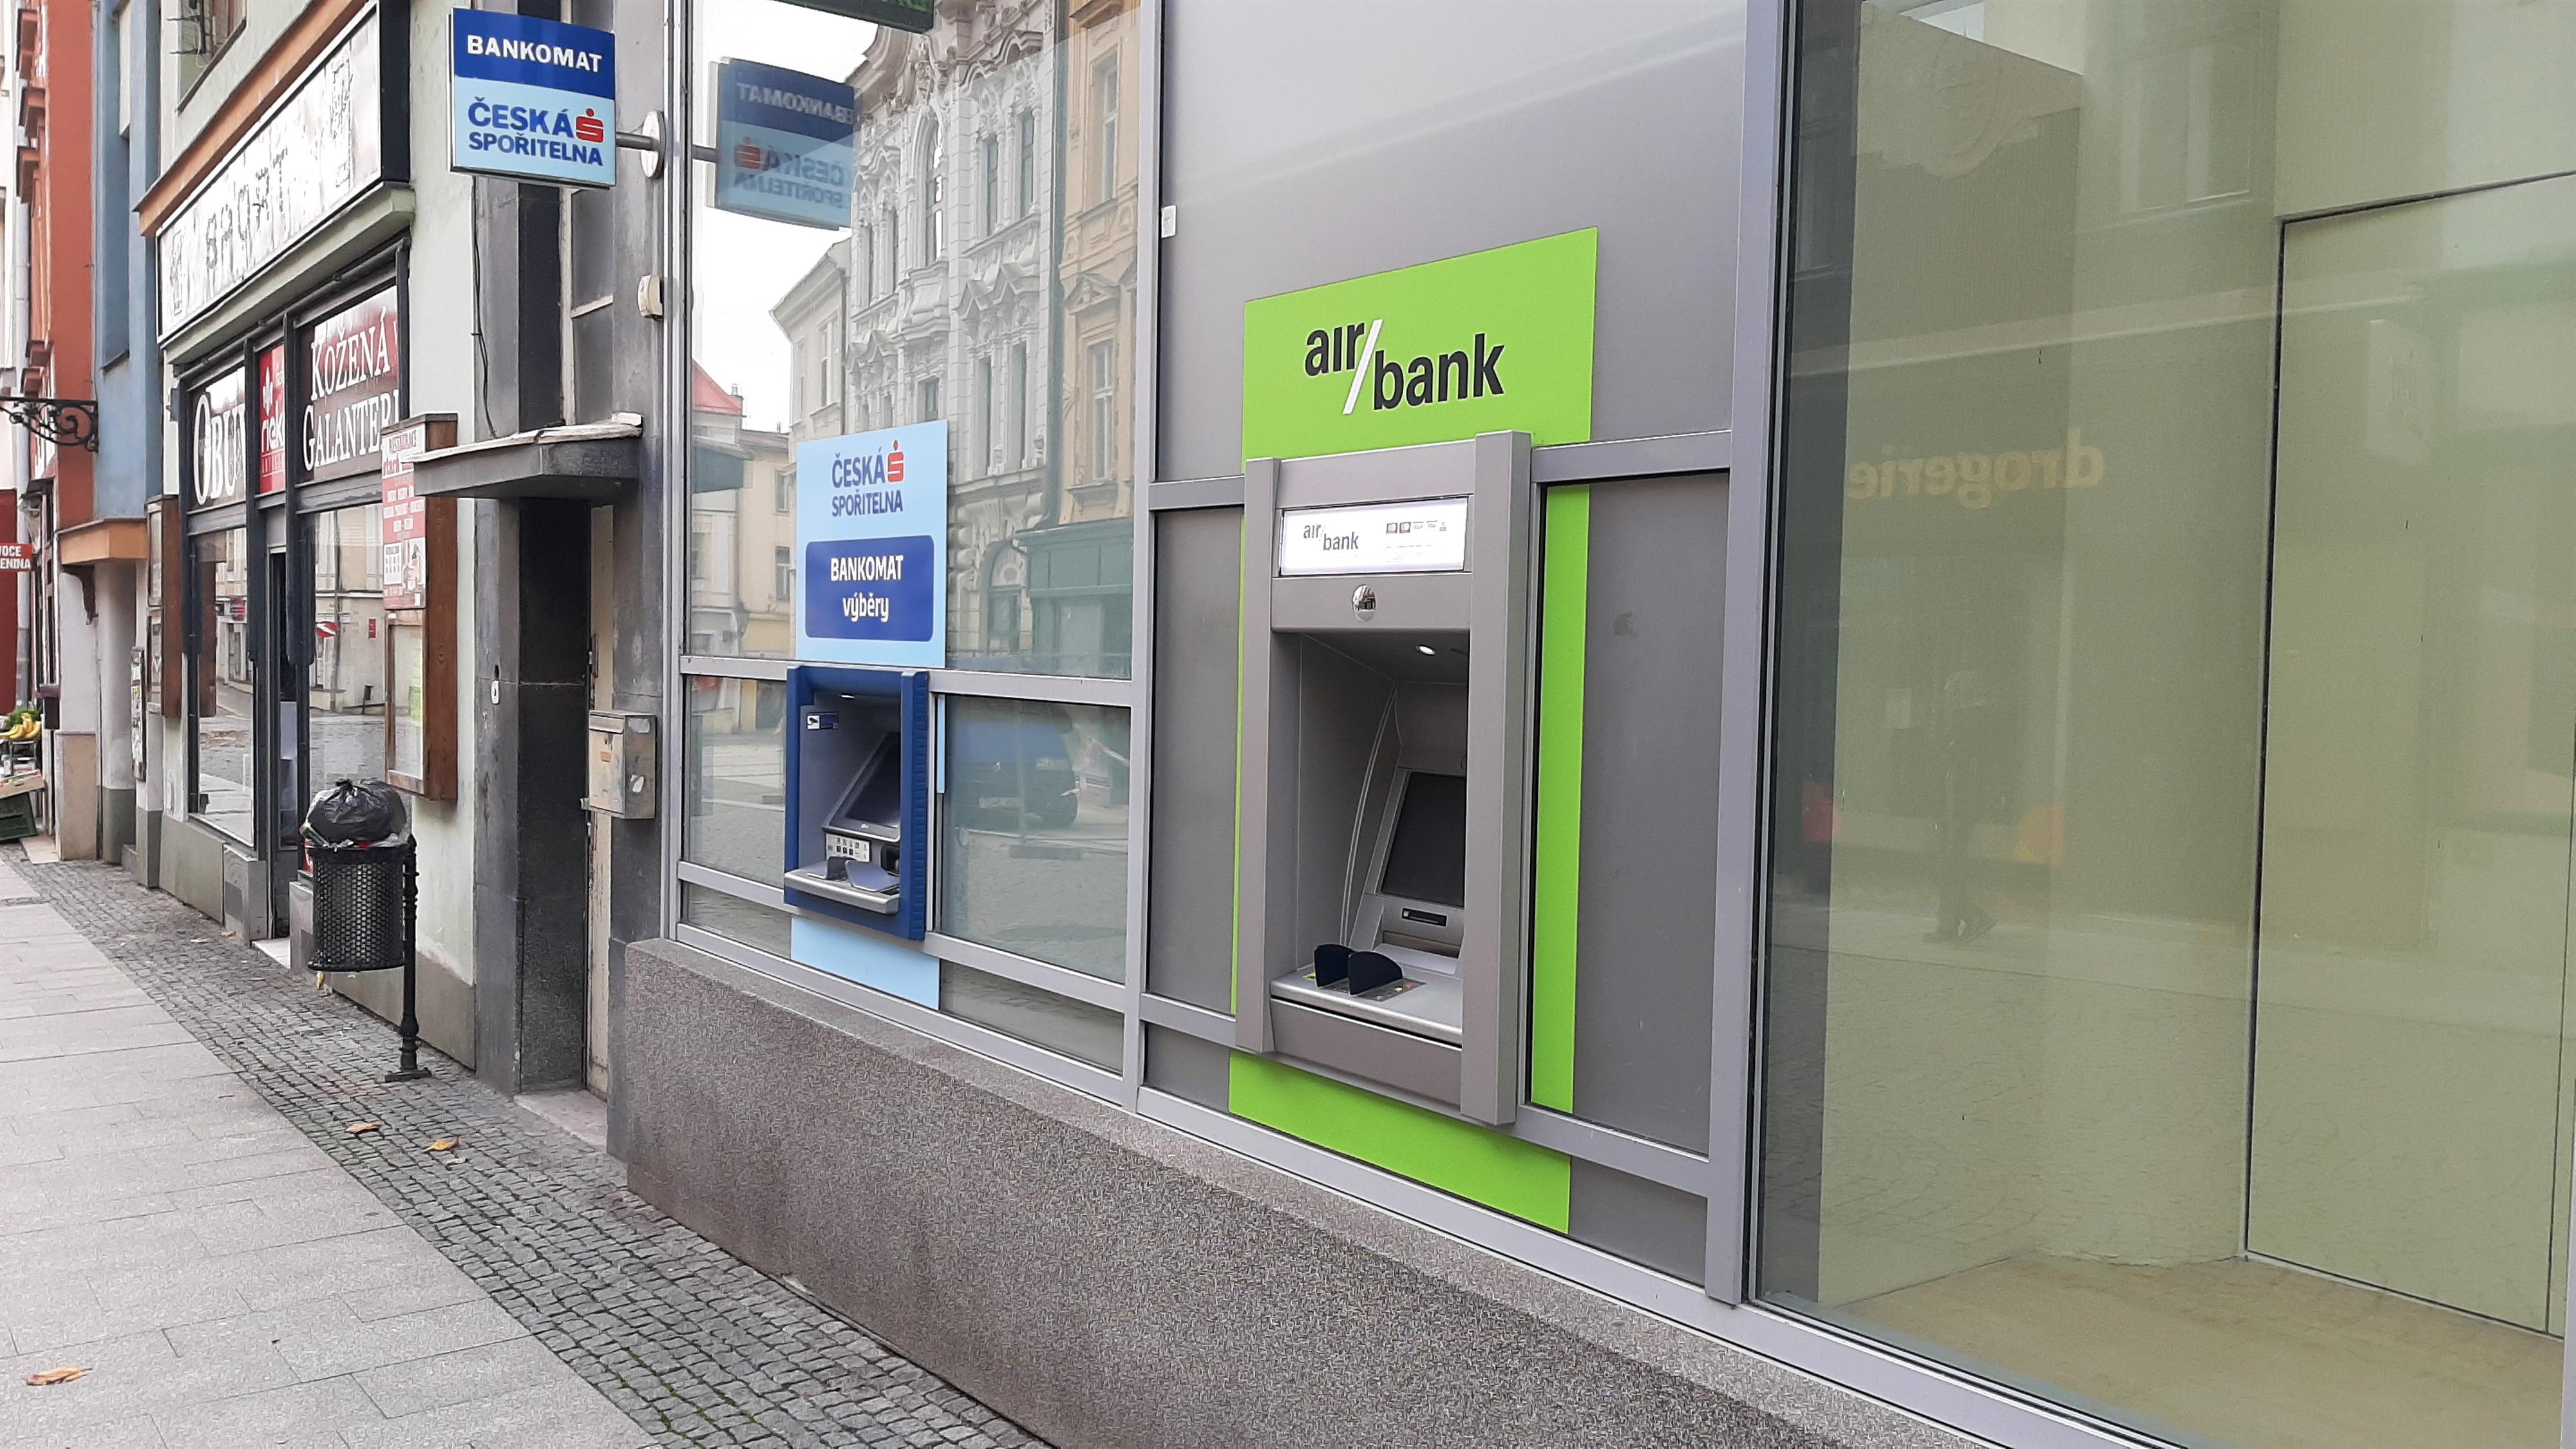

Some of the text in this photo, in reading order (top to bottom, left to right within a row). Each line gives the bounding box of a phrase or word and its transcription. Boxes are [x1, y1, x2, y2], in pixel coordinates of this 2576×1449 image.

[466, 34, 603, 73] BANKOMAT
[468, 97, 575, 138] ČESKÁ
[468, 133, 603, 167] SPOŘITELNA
[831, 447, 886, 488] ČESKÁ
[831, 489, 904, 517] SPOŘITELNA
[1323, 531, 1359, 551] bank
[830, 554, 904, 581] BANKOMAT
[842, 592, 889, 623] výběry
